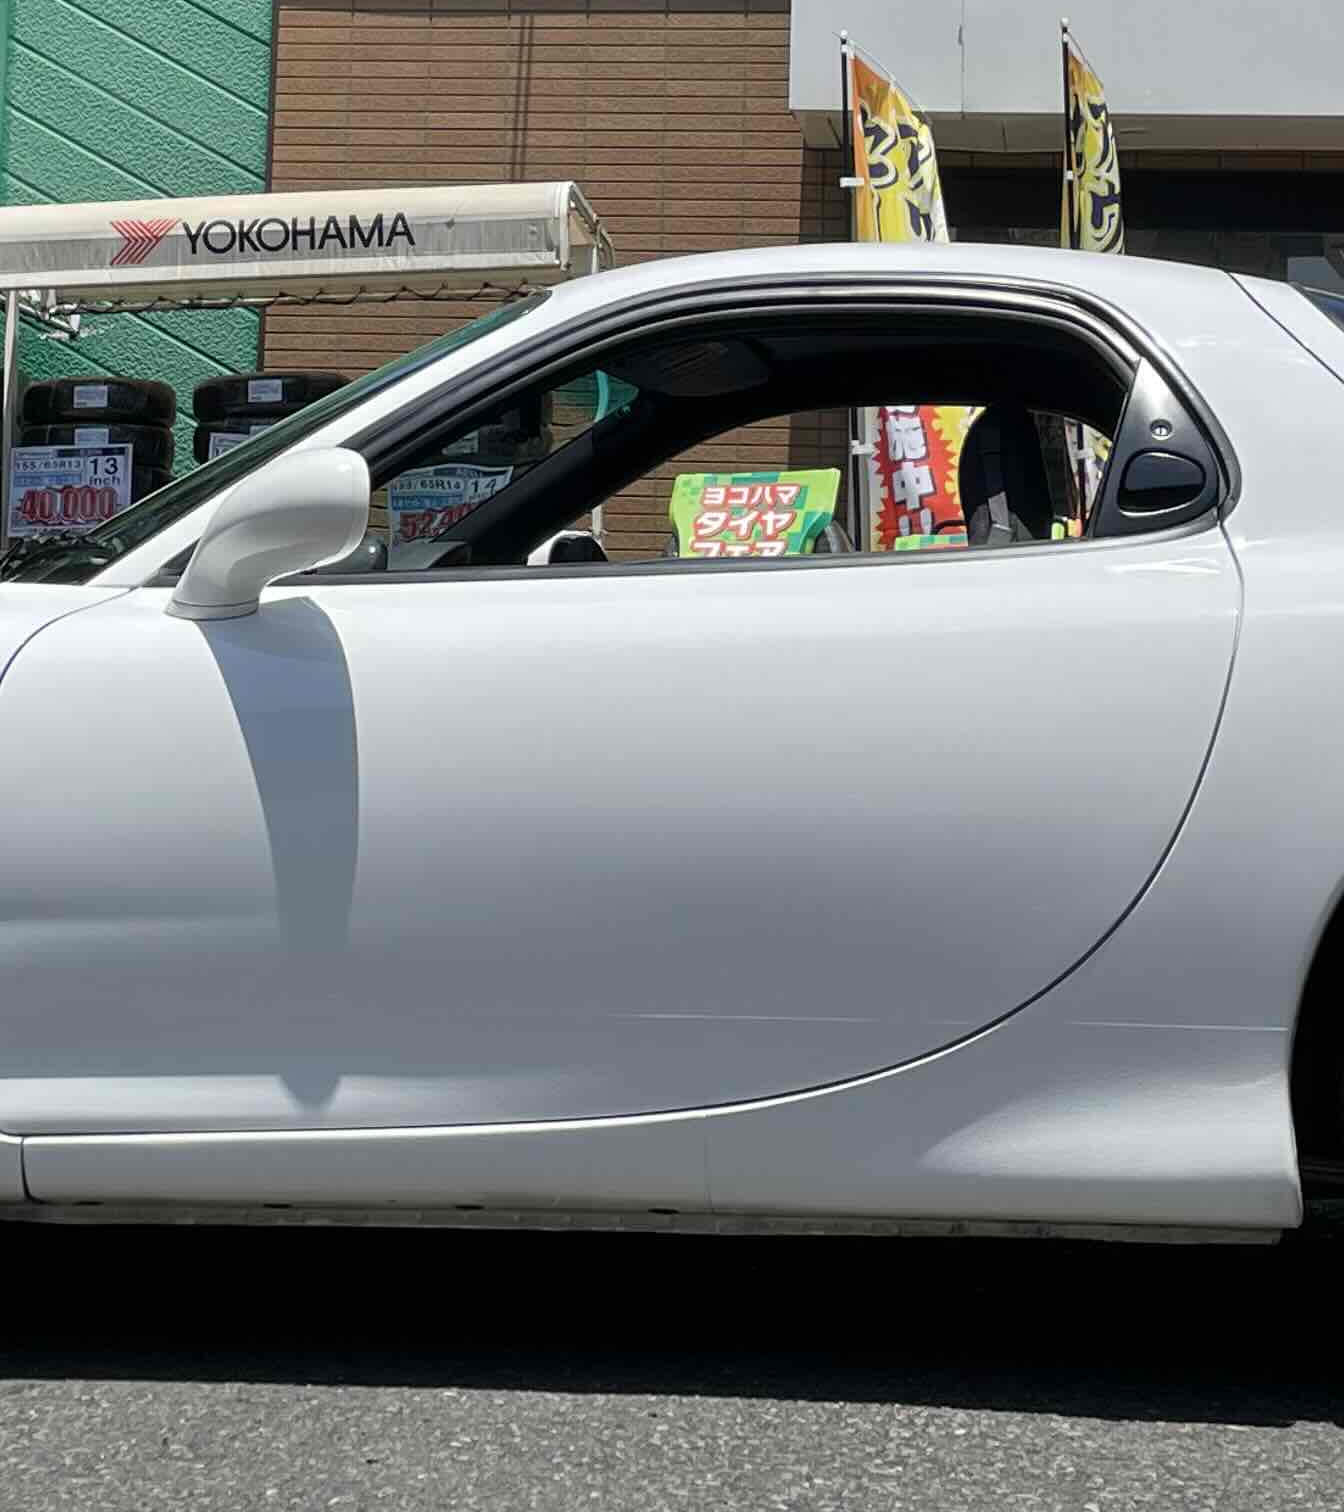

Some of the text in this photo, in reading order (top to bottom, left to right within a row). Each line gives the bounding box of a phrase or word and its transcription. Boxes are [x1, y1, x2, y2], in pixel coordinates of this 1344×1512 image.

[182, 212, 416, 255] YOKOHAMA
[89, 456, 119, 476] 13
[701, 484, 800, 505] ヨコハマ
[694, 510, 796, 538] タイヤ
